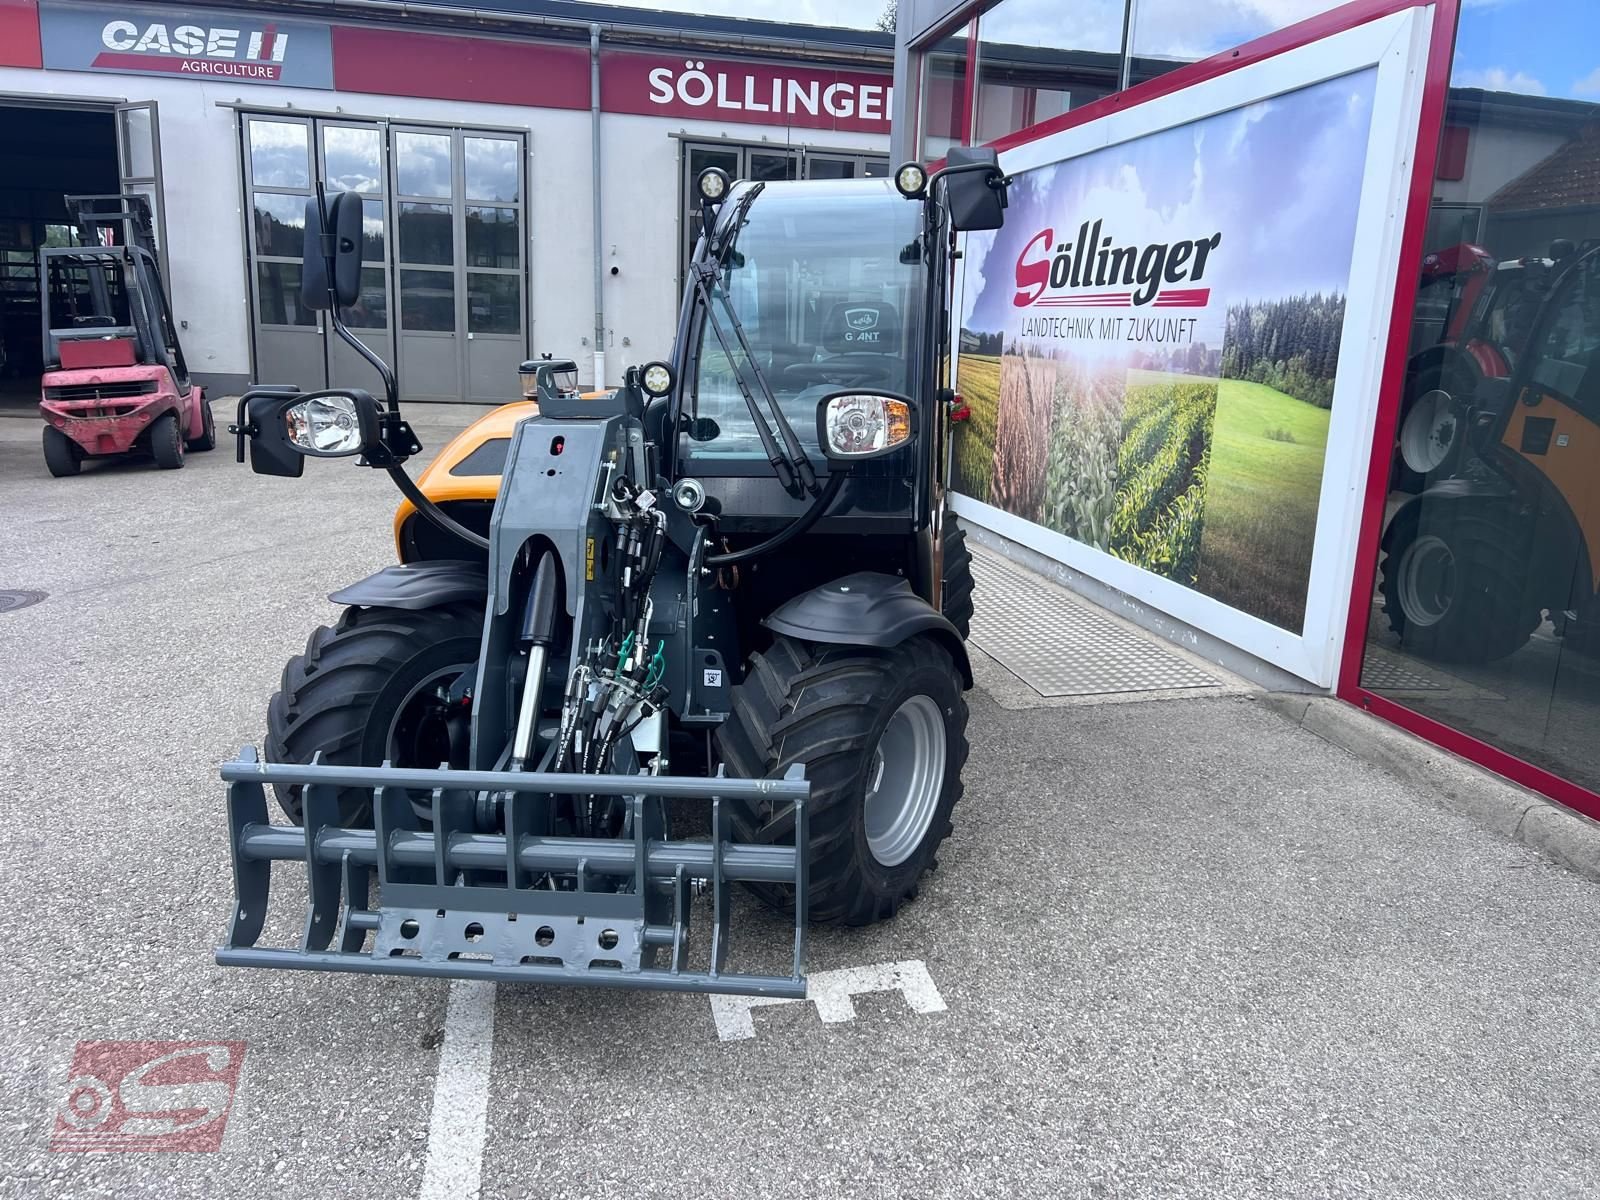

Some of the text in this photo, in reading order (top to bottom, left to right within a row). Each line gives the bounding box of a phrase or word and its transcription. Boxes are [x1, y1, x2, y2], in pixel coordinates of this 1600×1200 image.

[101, 20, 240, 58] CASE
[181, 61, 274, 78] AGRICULTURE
[1013, 218, 1222, 307] Söllinger
[844, 331, 880, 341] GANT
[1021, 317, 1198, 344] LANDTECHNIK MIT ZUKUNFT
